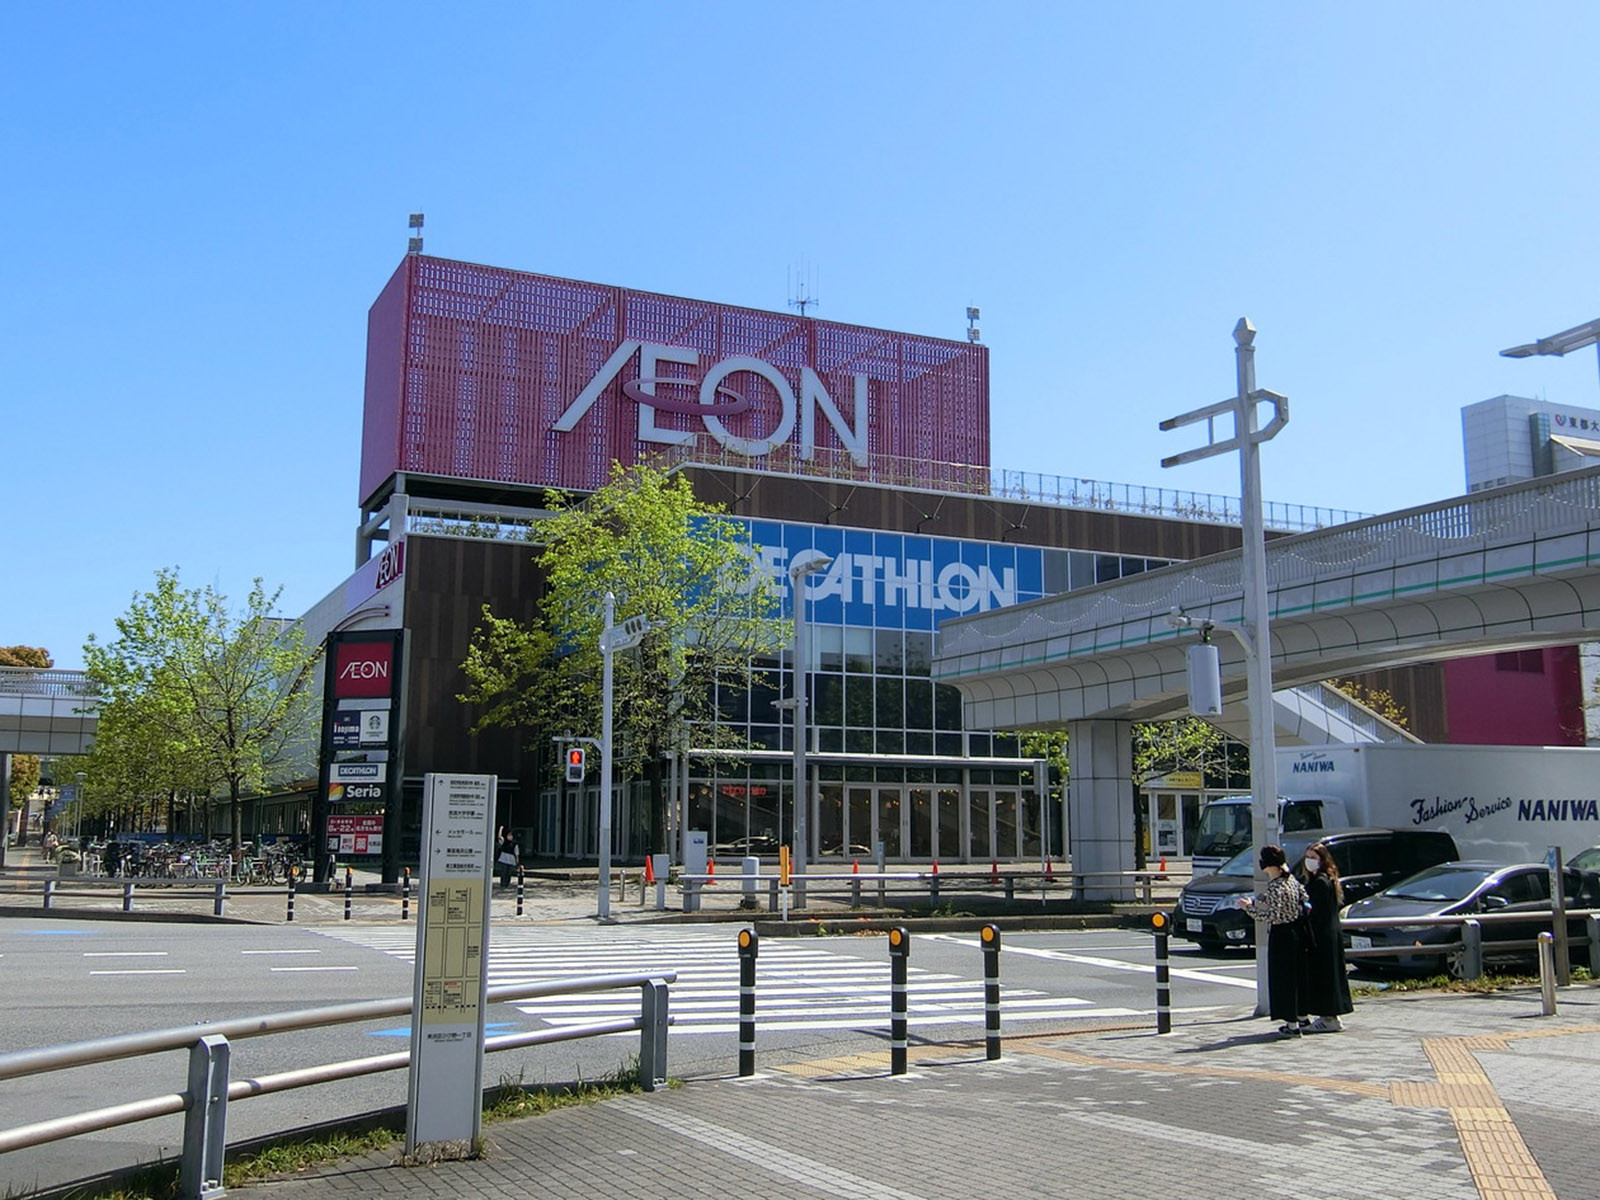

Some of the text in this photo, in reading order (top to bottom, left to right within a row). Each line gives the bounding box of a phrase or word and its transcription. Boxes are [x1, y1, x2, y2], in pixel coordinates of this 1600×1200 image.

[1293, 761, 1335, 773] NANIWA
[346, 785, 381, 798] Seria
[1410, 796, 1600, 825] Fashion Service NANIWA
